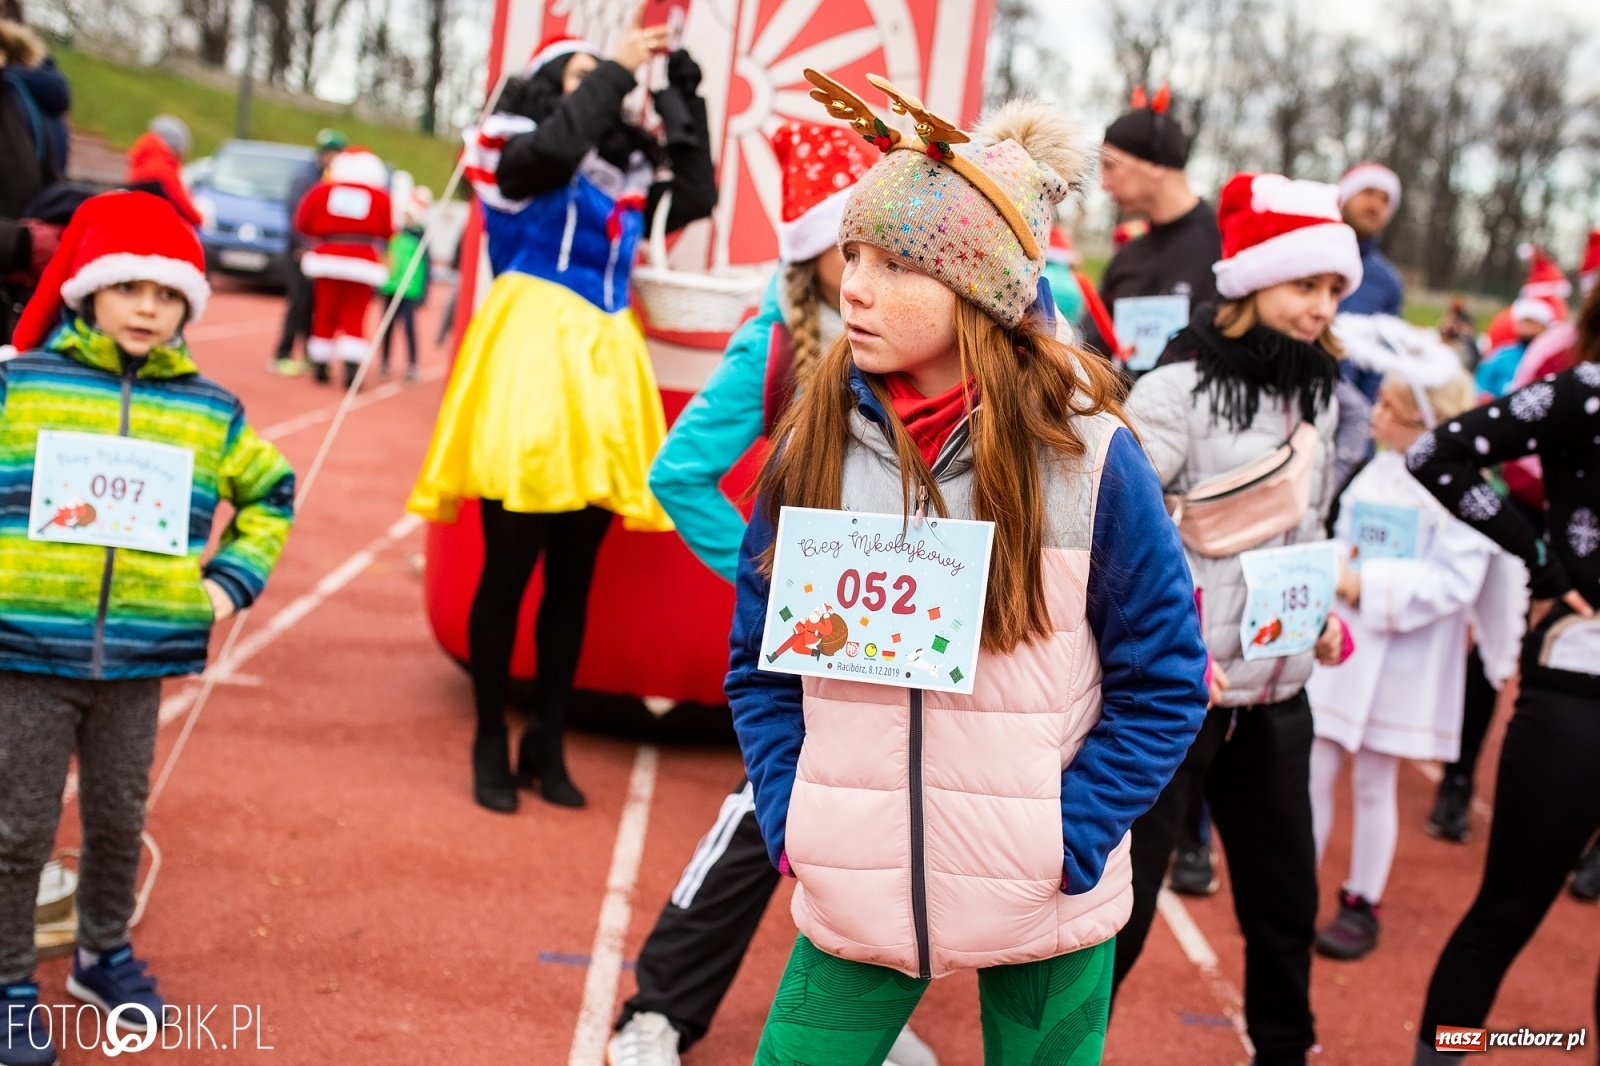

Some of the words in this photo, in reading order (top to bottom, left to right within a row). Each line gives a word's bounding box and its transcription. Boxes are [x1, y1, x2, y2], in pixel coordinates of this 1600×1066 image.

[90, 474, 145, 503] 097
[797, 538, 843, 559] Bieg
[836, 568, 917, 615] 052
[1282, 584, 1309, 614] 183
[837, 662, 867, 675] Racibórz,
[868, 665, 900, 677] 8.12.2019
